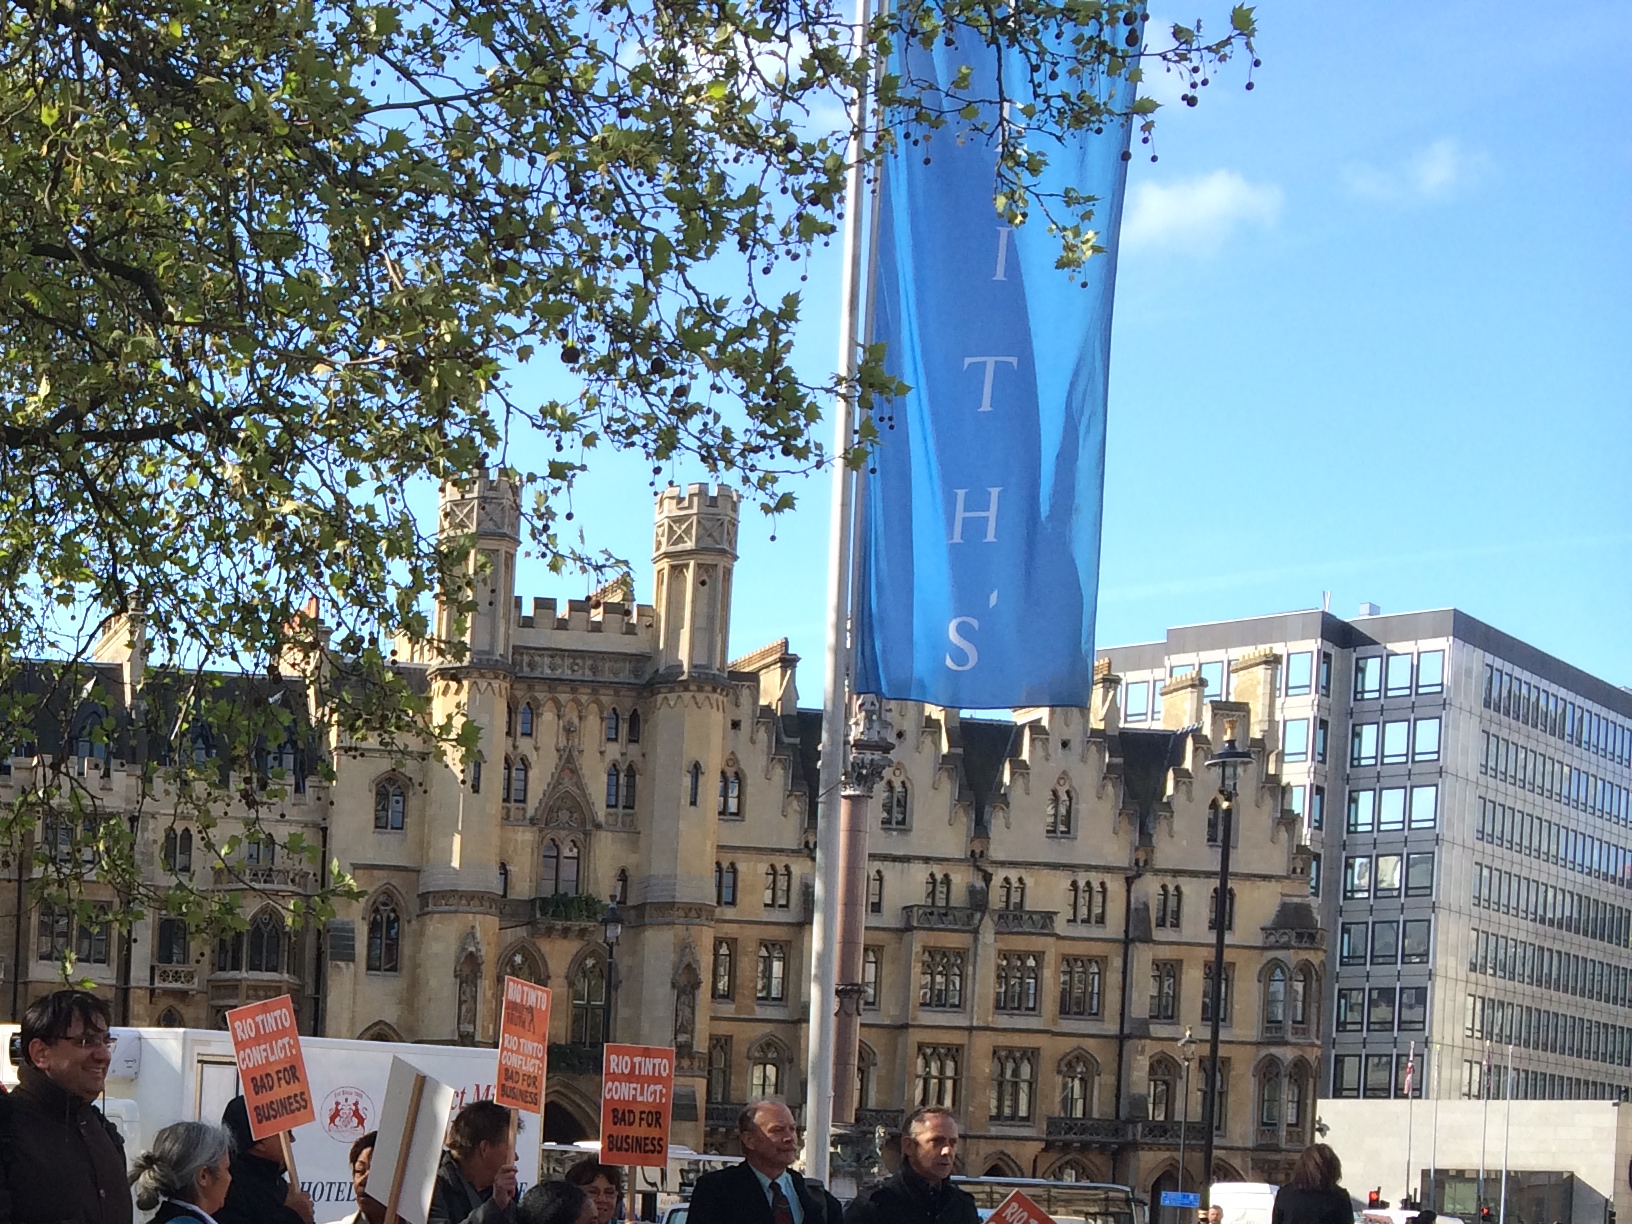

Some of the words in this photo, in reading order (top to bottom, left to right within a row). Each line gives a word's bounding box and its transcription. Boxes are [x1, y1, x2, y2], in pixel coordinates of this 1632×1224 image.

[508, 982, 522, 1002] RIO
[522, 986, 547, 1011] TINTO
[234, 1018, 256, 1042] RIO
[256, 1008, 291, 1034] TINTO
[238, 1036, 296, 1071] CONFLICT:
[504, 1034, 518, 1051] RIO
[520, 1038, 544, 1059] TINTO
[501, 1050, 543, 1075] CONFLICT:
[609, 1054, 631, 1075] RIO
[633, 1057, 669, 1077] TINTO
[251, 1073, 275, 1096] BAD
[277, 1064, 301, 1088] FOR
[504, 1067, 521, 1083] BAD
[521, 1073, 538, 1090] FOR
[501, 1083, 538, 1106] BUSINESS
[604, 1082, 666, 1104] CONFLICT:
[253, 1091, 309, 1125] BUSINESS
[611, 1107, 635, 1127] BAD
[638, 1109, 662, 1129] FOR
[607, 1134, 664, 1155] BUSINESS
